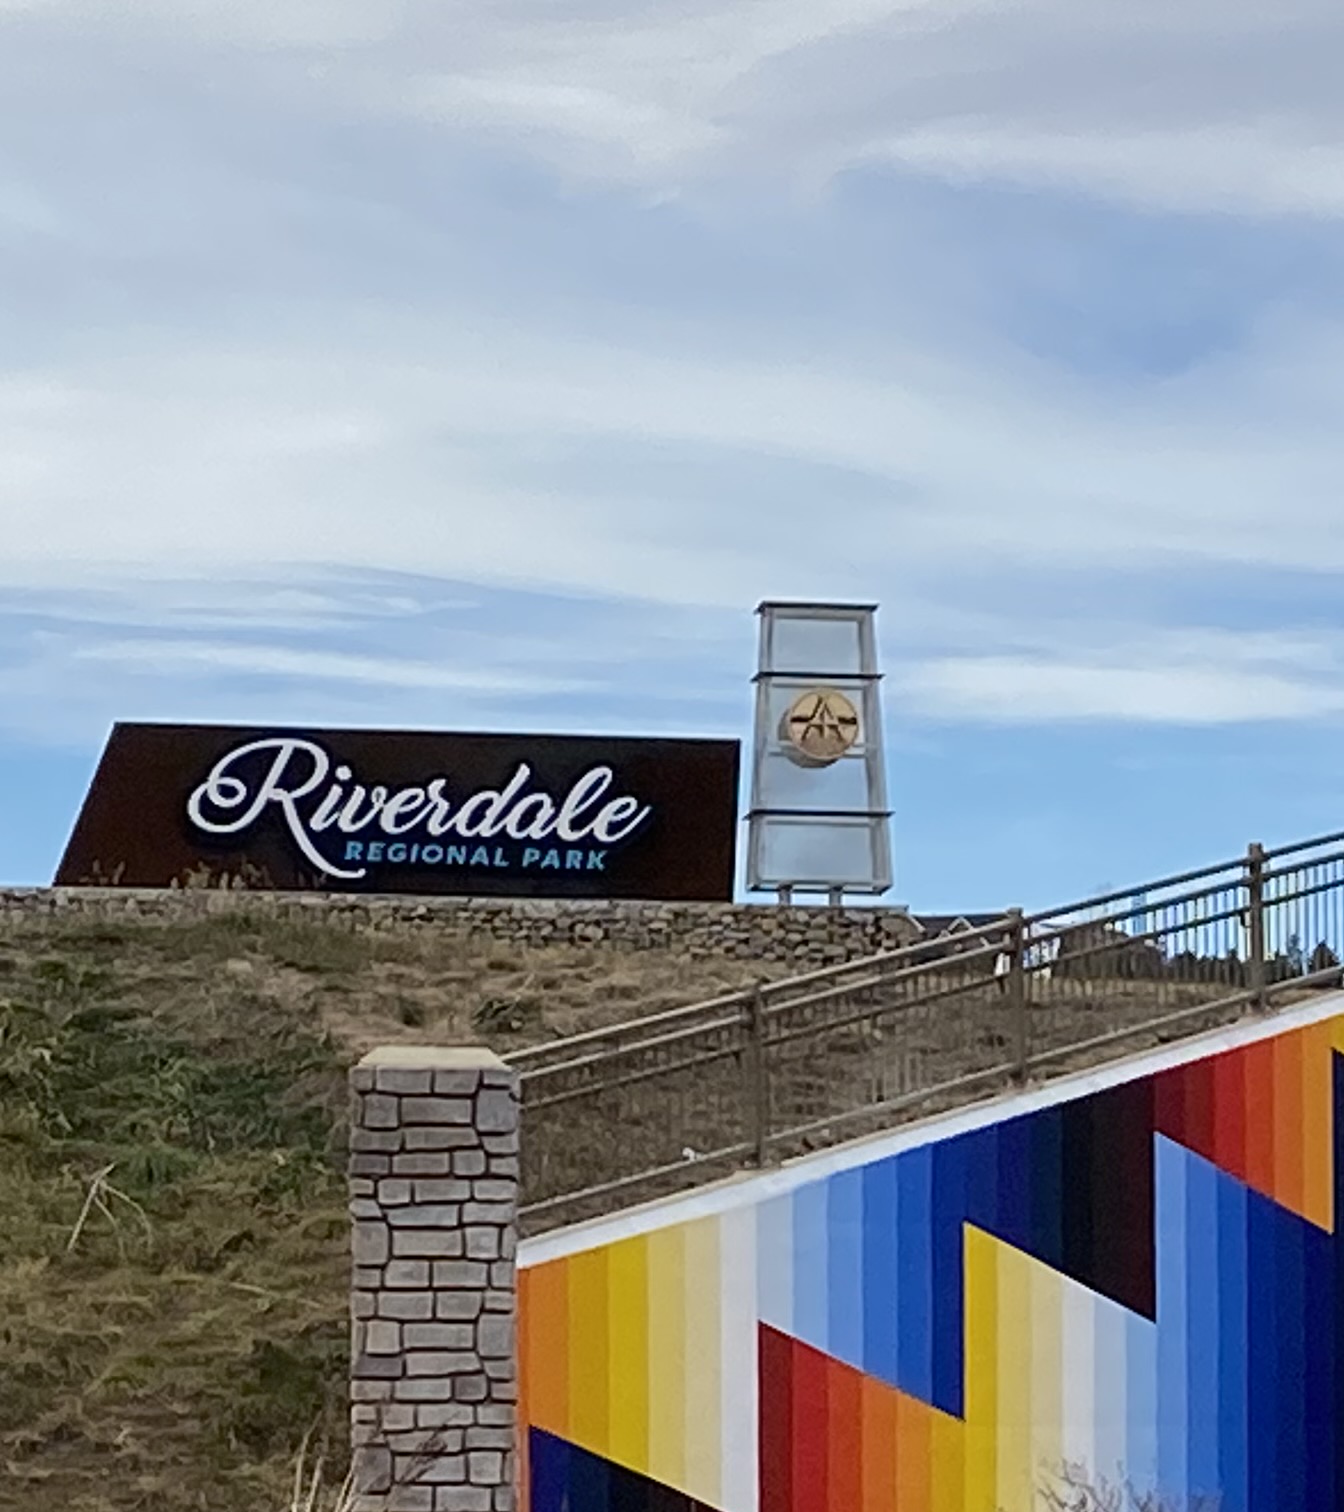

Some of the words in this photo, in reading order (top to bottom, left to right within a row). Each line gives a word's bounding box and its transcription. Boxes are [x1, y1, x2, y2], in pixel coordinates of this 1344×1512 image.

[187, 737, 652, 879] Riverdale
[344, 840, 510, 867] REGIONAL
[521, 847, 608, 872] PARK
